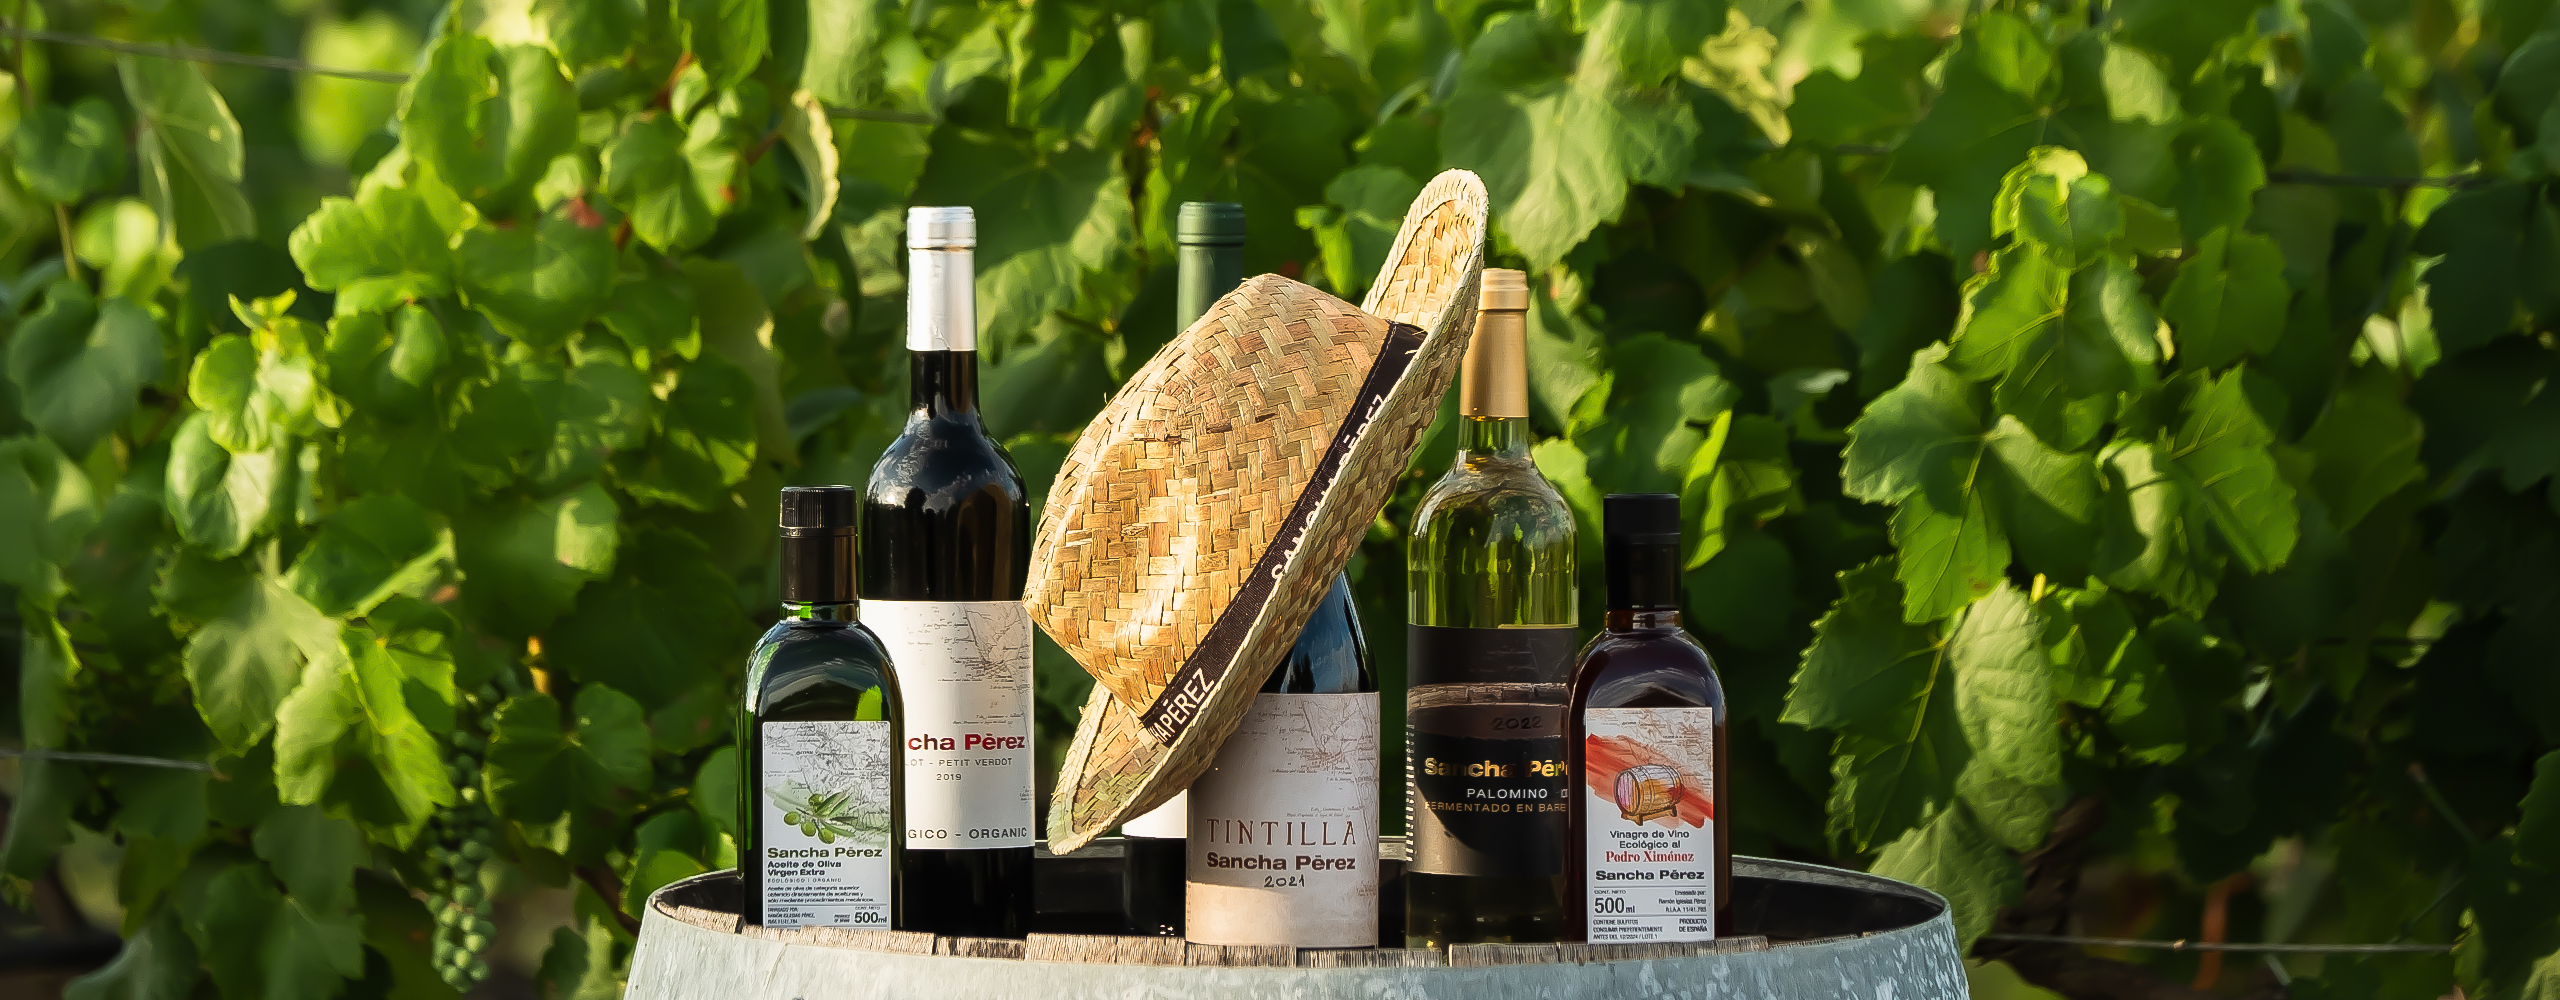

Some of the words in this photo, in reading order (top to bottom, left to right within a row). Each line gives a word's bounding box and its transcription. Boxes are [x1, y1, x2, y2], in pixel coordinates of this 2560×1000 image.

[1491, 716, 1542, 730] 2022
[974, 758, 1012, 766] VERDOT
[1425, 758, 1516, 777] Sancha
[1467, 788, 1547, 798] PALOMINO
[1425, 802, 1510, 812] FERMENTADO
[1517, 804, 1533, 812] EN
[969, 827, 1027, 839] ORGANIC
[1207, 818, 1356, 846] TINTILLA
[1610, 830, 1648, 840] Vinagre
[1668, 830, 1689, 838] Vino
[1620, 840, 1668, 850] Ecológico
[1672, 840, 1680, 848] al
[768, 847, 829, 858] Sancha
[1606, 851, 1640, 862] Pedro
[1207, 852, 1286, 870] Sancha
[1264, 874, 1304, 887] 2021
[1596, 870, 1654, 880] Sancha
